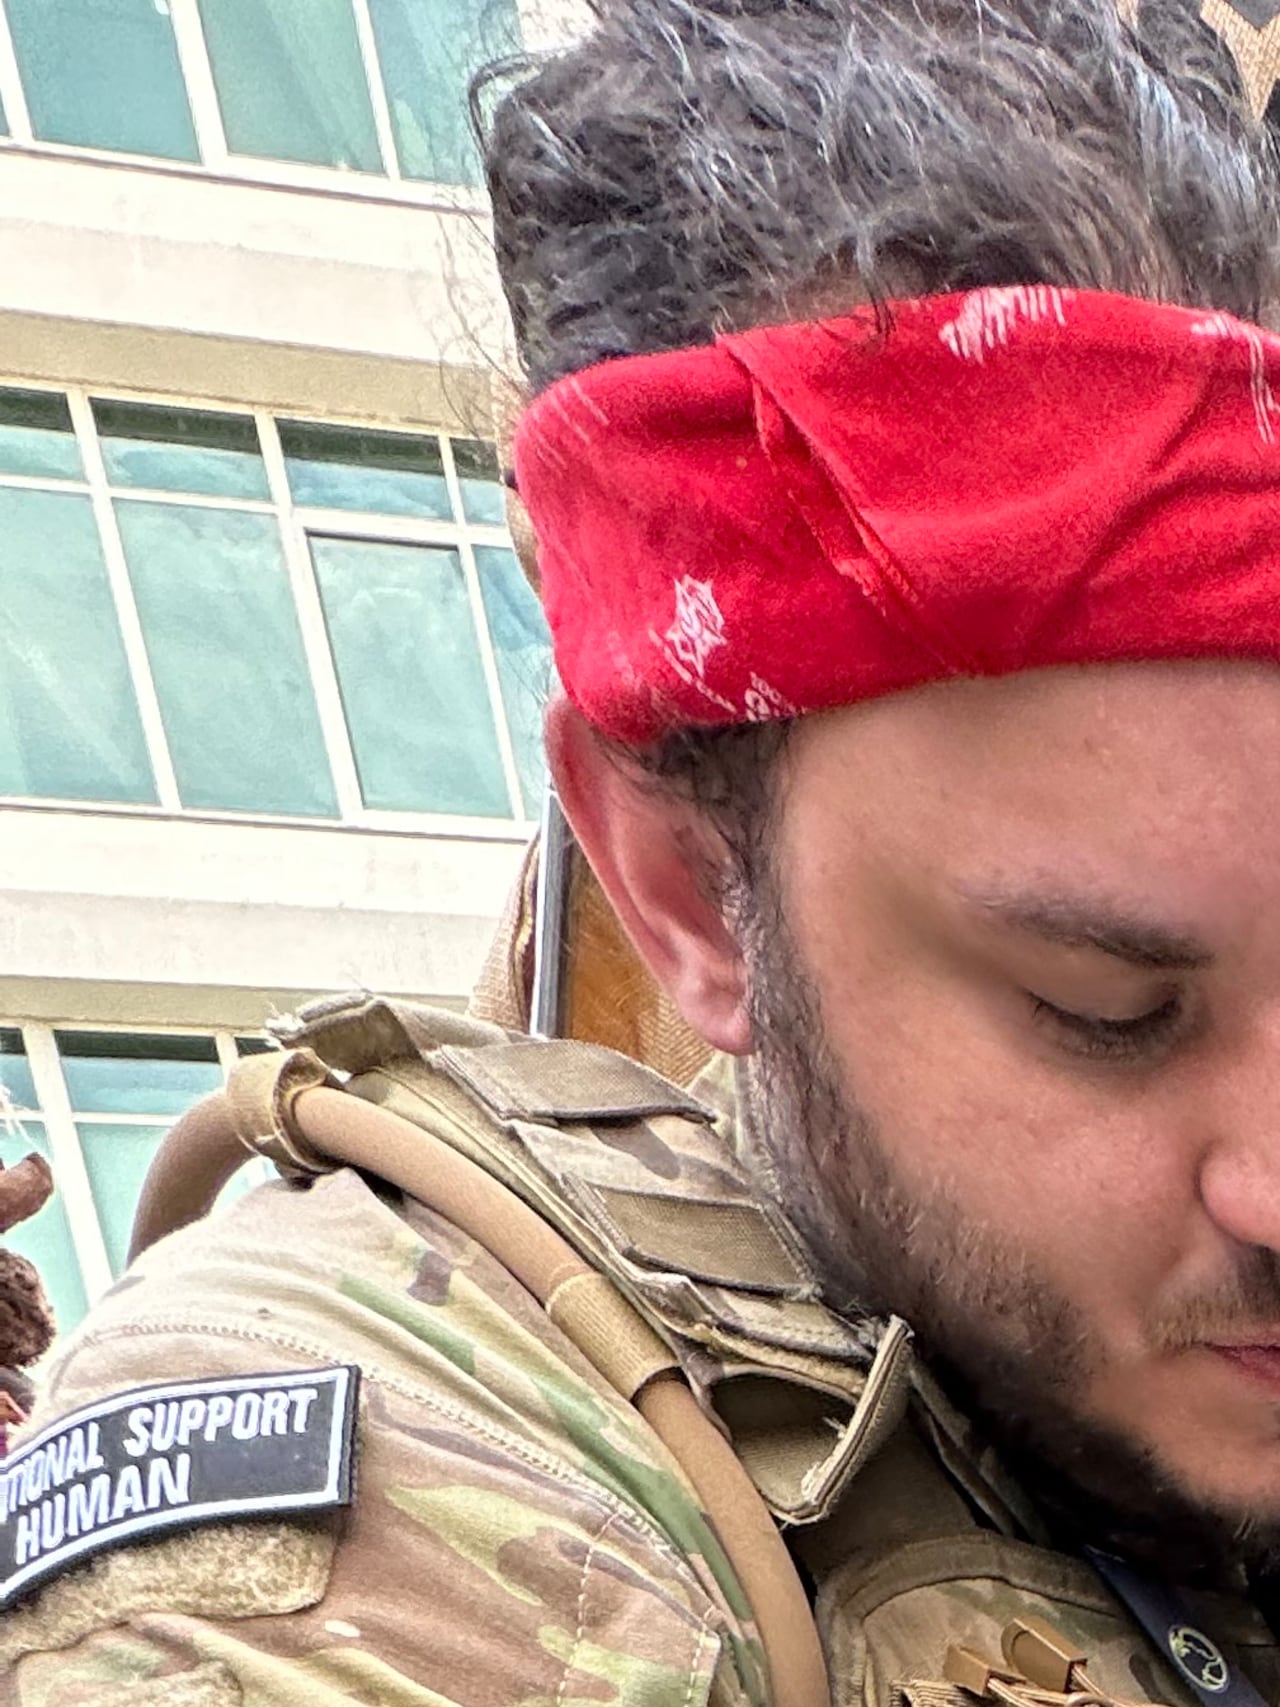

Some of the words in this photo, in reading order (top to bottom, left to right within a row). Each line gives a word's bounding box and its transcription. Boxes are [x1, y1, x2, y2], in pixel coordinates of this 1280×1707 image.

[0, 1421, 105, 1524] TIONAL
[123, 1388, 319, 1457] SUPPORT
[16, 1453, 191, 1565] HUMAN
